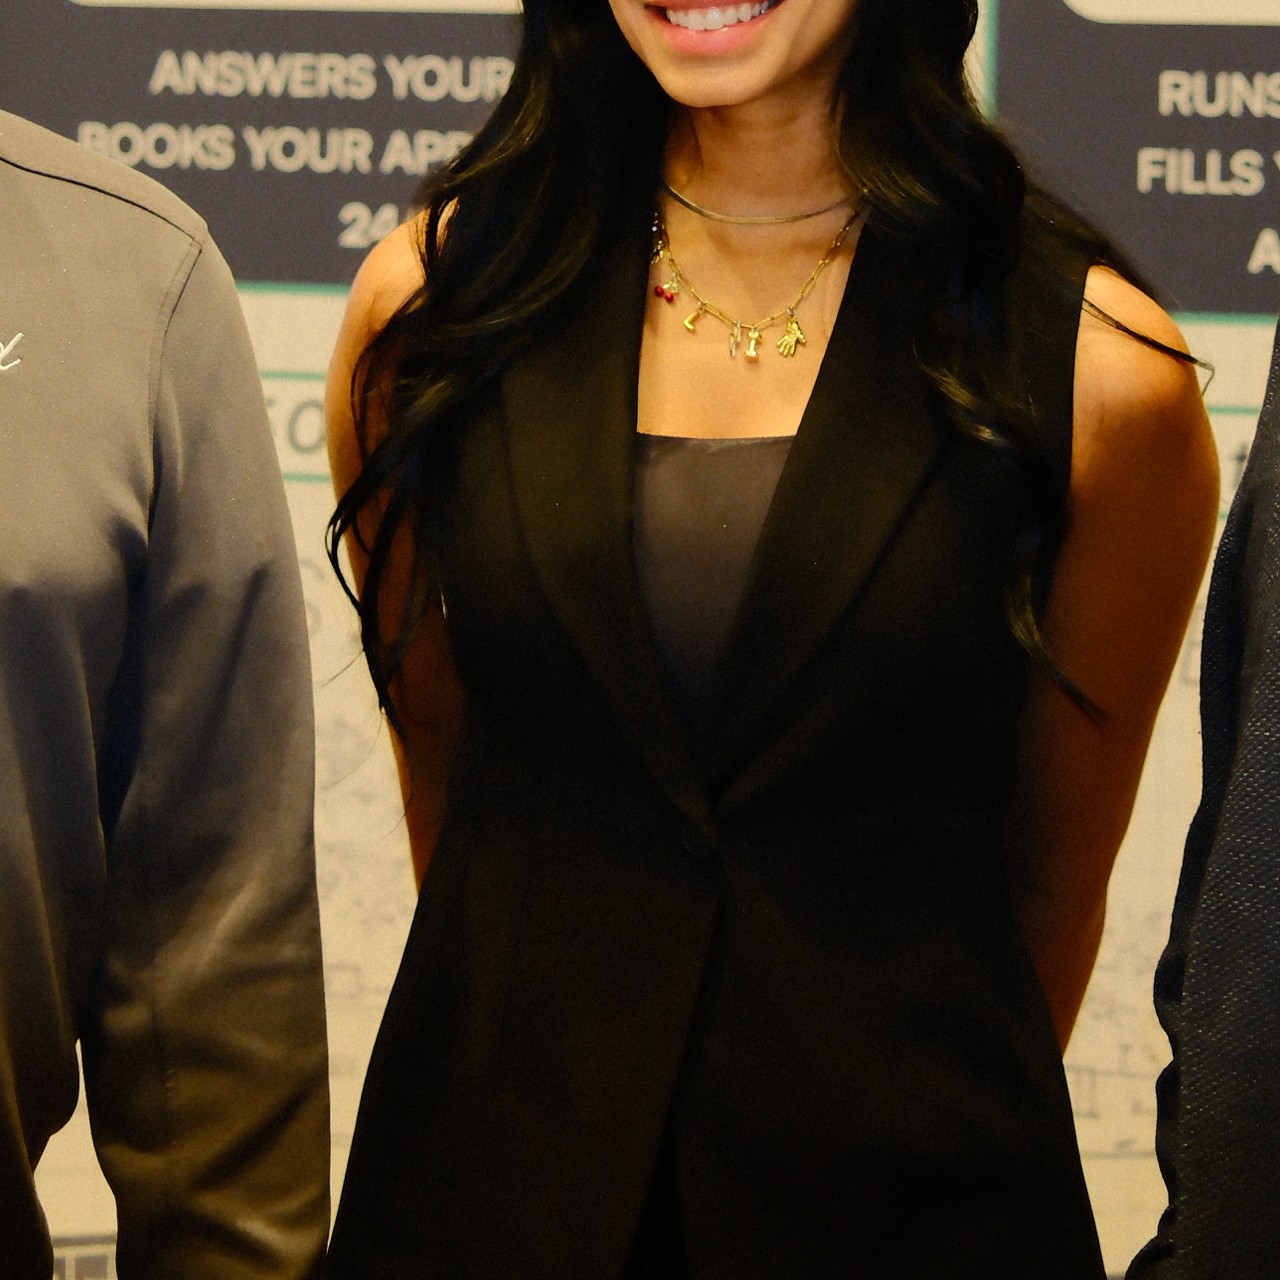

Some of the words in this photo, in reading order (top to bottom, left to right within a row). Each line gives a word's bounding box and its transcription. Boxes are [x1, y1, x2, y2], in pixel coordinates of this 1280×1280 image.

[150, 50, 377, 100] ANSWERS
[382, 55, 515, 103] YOUR
[243, 125, 374, 175] YOUR
[1136, 147, 1265, 198] FILLS
